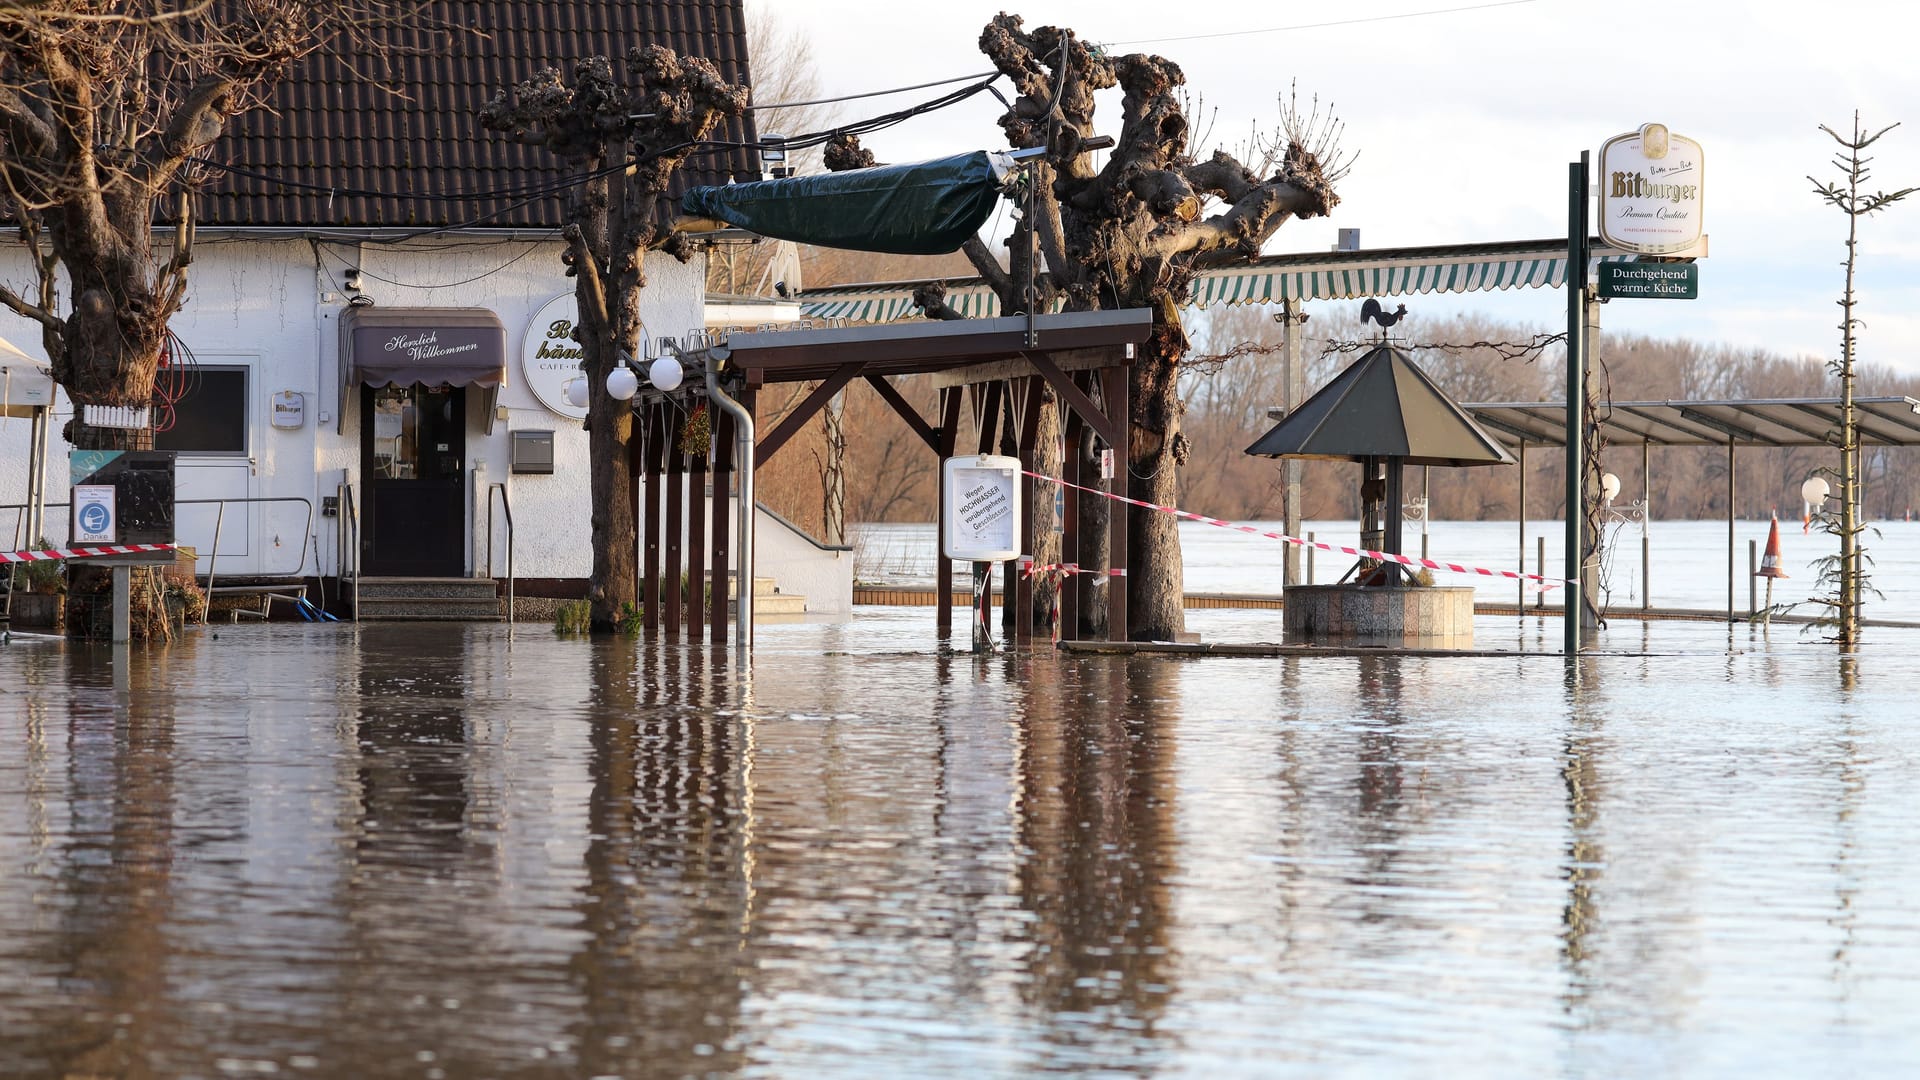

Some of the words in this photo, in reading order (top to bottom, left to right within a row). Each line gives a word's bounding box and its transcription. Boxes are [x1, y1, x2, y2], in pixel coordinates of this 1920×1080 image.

[1610, 171, 1697, 203] Bitburger
[1616, 206, 1653, 219] Premium
[1656, 206, 1688, 220] Qualität
[1612, 268, 1688, 281] Durchgehend
[1612, 284, 1650, 293] warme
[1654, 283, 1688, 293] Küche
[384, 330, 438, 352] Herzlich
[535, 340, 584, 360] häus
[407, 343, 479, 361] Willkommen
[959, 485, 1000, 515] HOCHWASSER
[964, 484, 985, 500] Wegen
[965, 493, 1006, 524] vorübergehend
[972, 505, 1008, 531] Geschlossen
[83, 532, 109, 541] Danke
